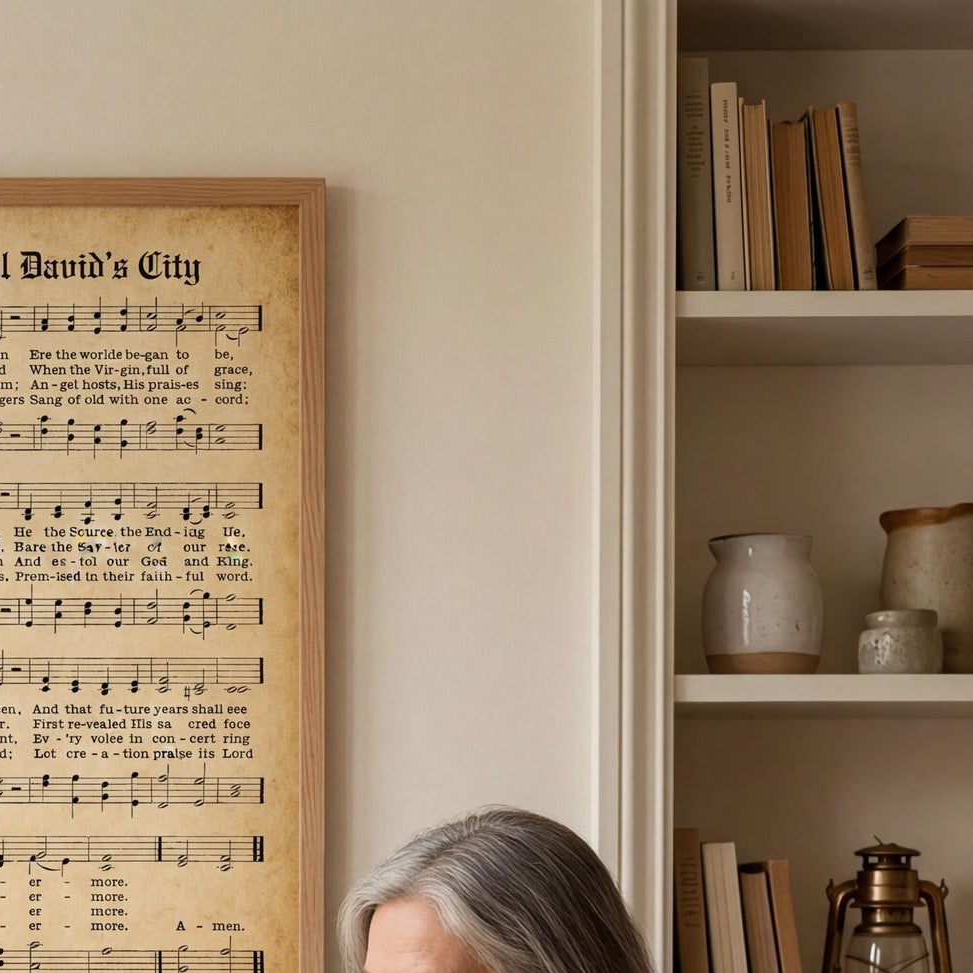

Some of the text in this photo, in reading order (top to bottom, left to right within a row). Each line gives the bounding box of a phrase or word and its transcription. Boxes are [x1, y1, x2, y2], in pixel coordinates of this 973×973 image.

[19, 250, 129, 280] David's
[138, 250, 202, 287] City
[29, 349, 53, 361] Ere
[55, 348, 77, 360] the
[79, 348, 123, 360] worlde
[175, 349, 190, 360] to
[214, 348, 234, 361] be,
[28, 364, 67, 376] When
[69, 363, 91, 376] the
[146, 364, 171, 376] full
[175, 364, 190, 376] of
[213, 366, 253, 377] grace,
[82, 379, 121, 392] hosts,
[122, 378, 145, 390] His
[29, 394, 64, 408] Sang
[67, 394, 82, 405] of
[84, 393, 105, 405] old
[108, 393, 140, 405] with
[143, 396, 169, 405] one
[13, 526, 33, 538] He
[119, 526, 143, 537] the
[13, 541, 47, 553] Bare
[50, 540, 73, 553] the
[183, 543, 207, 553] our
[13, 555, 42, 567] And
[106, 558, 130, 567] our
[184, 555, 210, 567] and
[102, 570, 135, 582] their
[215, 571, 253, 582] word.
[32, 703, 59, 715] And
[64, 703, 93, 715] that
[152, 705, 189, 717] years
[191, 703, 224, 715] shall
[32, 718, 65, 730] First
[187, 718, 217, 730] cred
[128, 733, 144, 744] in
[222, 732, 251, 747] ring
[221, 748, 254, 759] Lord
[28, 878, 42, 887] er
[90, 878, 128, 888] more.
[28, 893, 42, 902] er
[90, 893, 128, 902] more.
[28, 907, 42, 917] er
[28, 922, 42, 931] er
[90, 922, 129, 932] more.
[211, 922, 245, 932] men.
